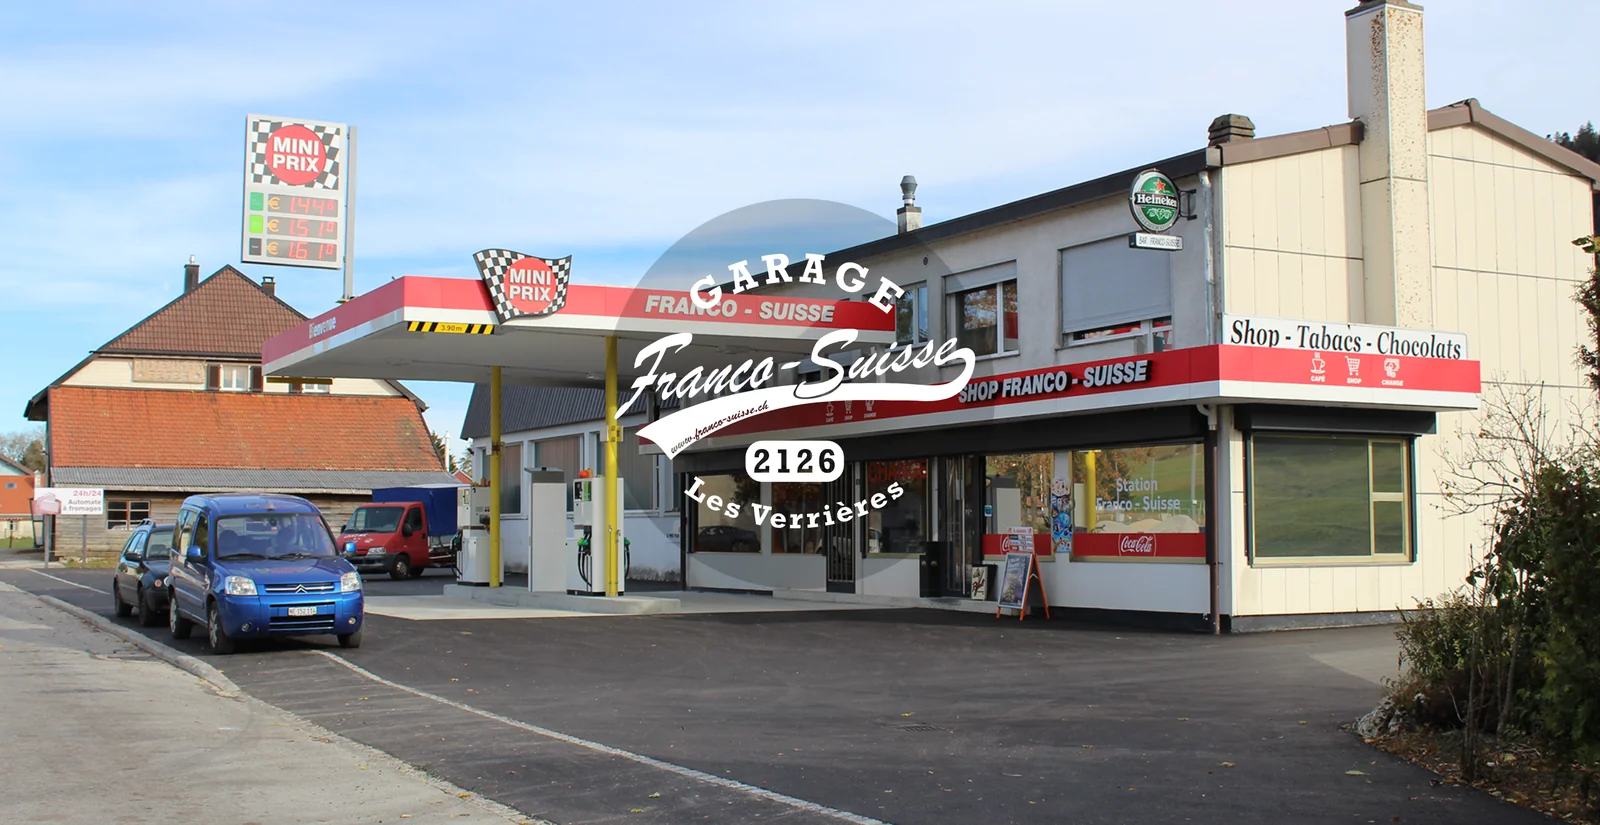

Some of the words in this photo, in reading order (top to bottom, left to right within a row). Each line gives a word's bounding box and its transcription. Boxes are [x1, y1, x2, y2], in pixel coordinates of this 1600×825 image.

[273, 136, 320, 156] MINI
[272, 153, 319, 172] PRIX
[1137, 194, 1177, 207] Heineken
[508, 268, 552, 286] MINI
[508, 284, 552, 303] PRIX
[759, 302, 836, 323] SUISSE
[1230, 319, 1280, 348] Shop
[1297, 325, 1362, 352] Tabacs
[1377, 331, 1461, 360] Chocolats
[958, 381, 999, 404] SHOP
[1001, 371, 1068, 398] FRANCO
[1082, 360, 1149, 387] SUISSE
[868, 459, 927, 482] CHANGE
[1116, 477, 1158, 492] Station
[1096, 498, 1133, 511] Franco
[1143, 496, 1181, 511] Suisse
